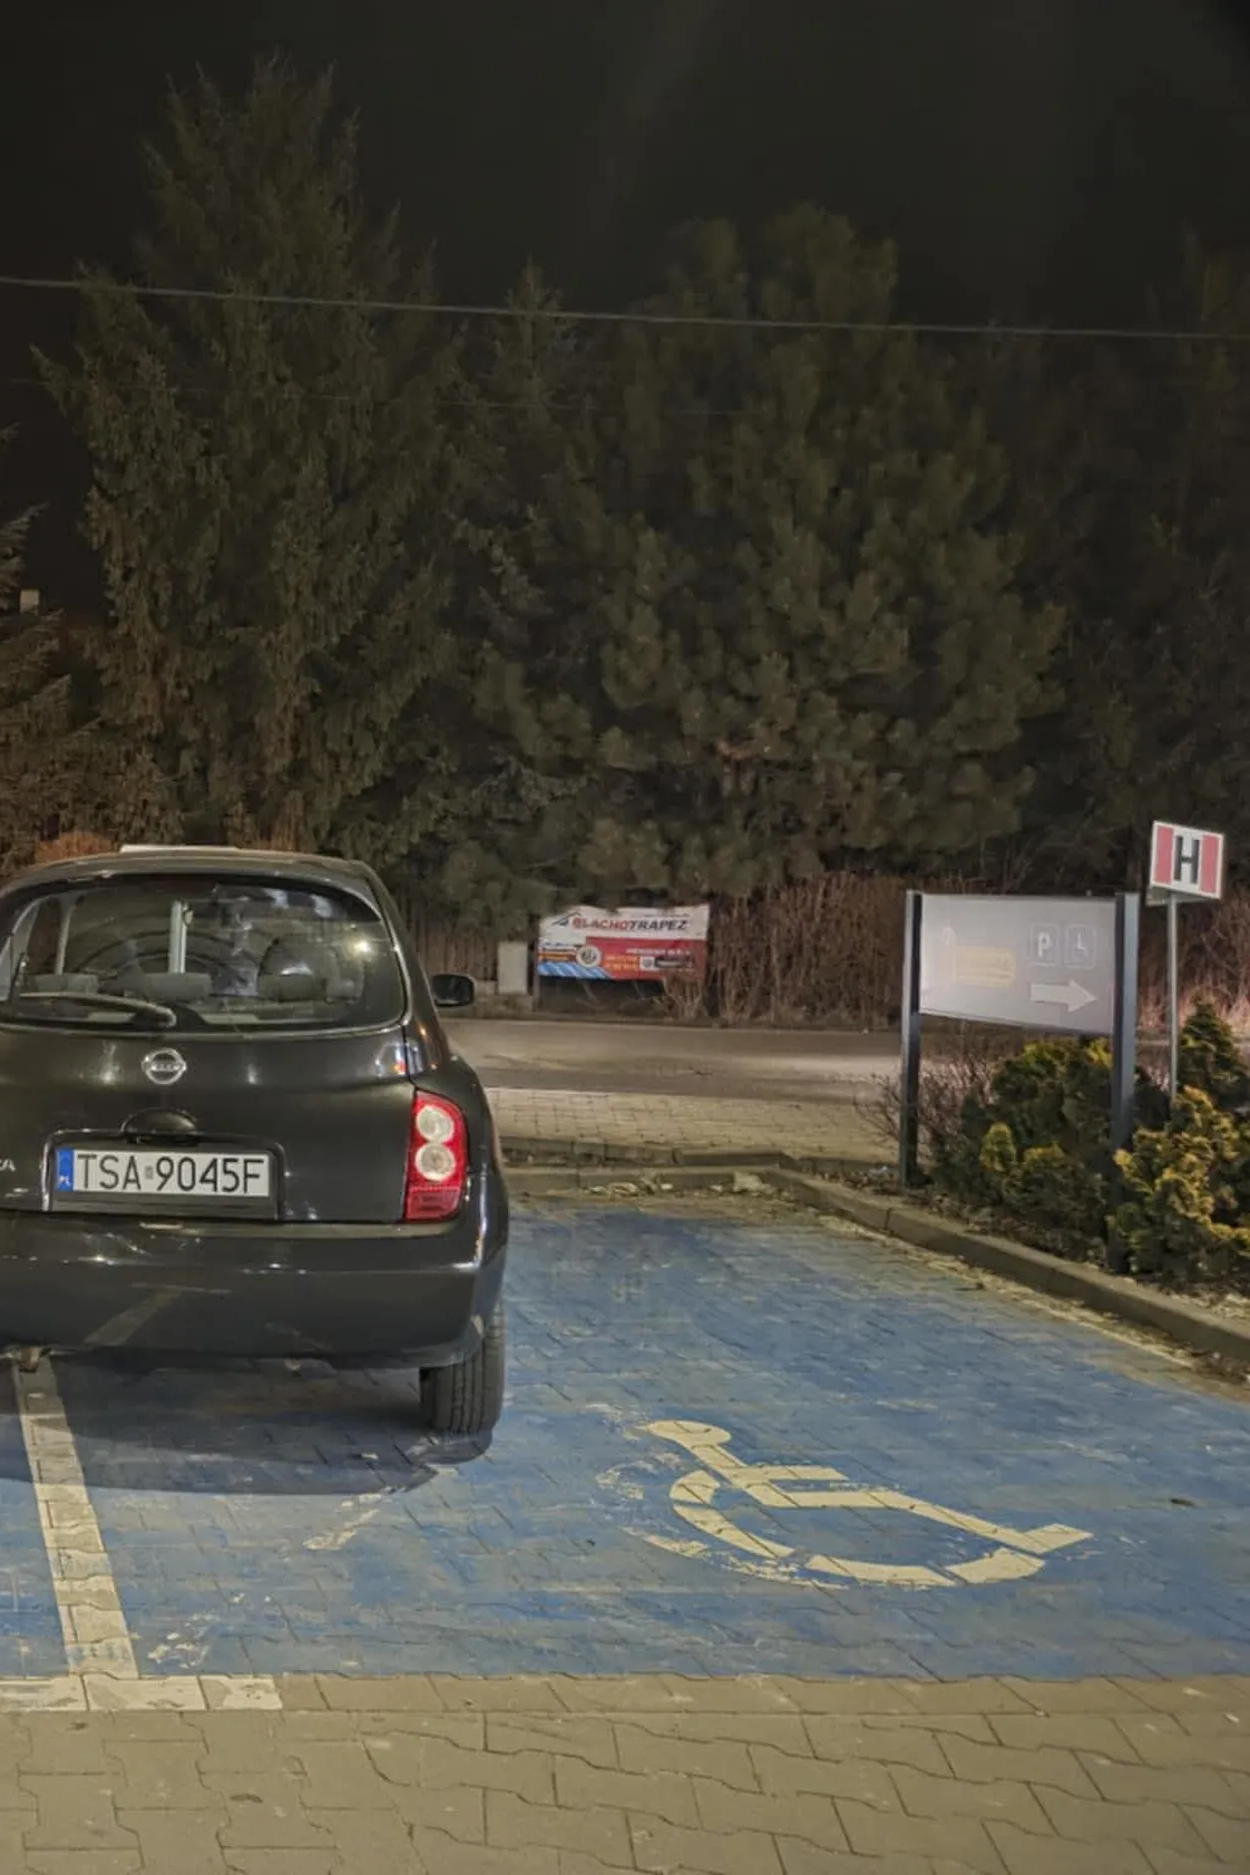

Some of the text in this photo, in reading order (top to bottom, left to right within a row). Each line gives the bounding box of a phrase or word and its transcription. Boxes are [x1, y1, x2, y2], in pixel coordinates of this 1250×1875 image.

[1173, 835, 1200, 885] H
[572, 916, 688, 931] BLACHOTRAPEZ
[1037, 931, 1051, 958] P
[77, 1153, 264, 1194] TSA 9045F
